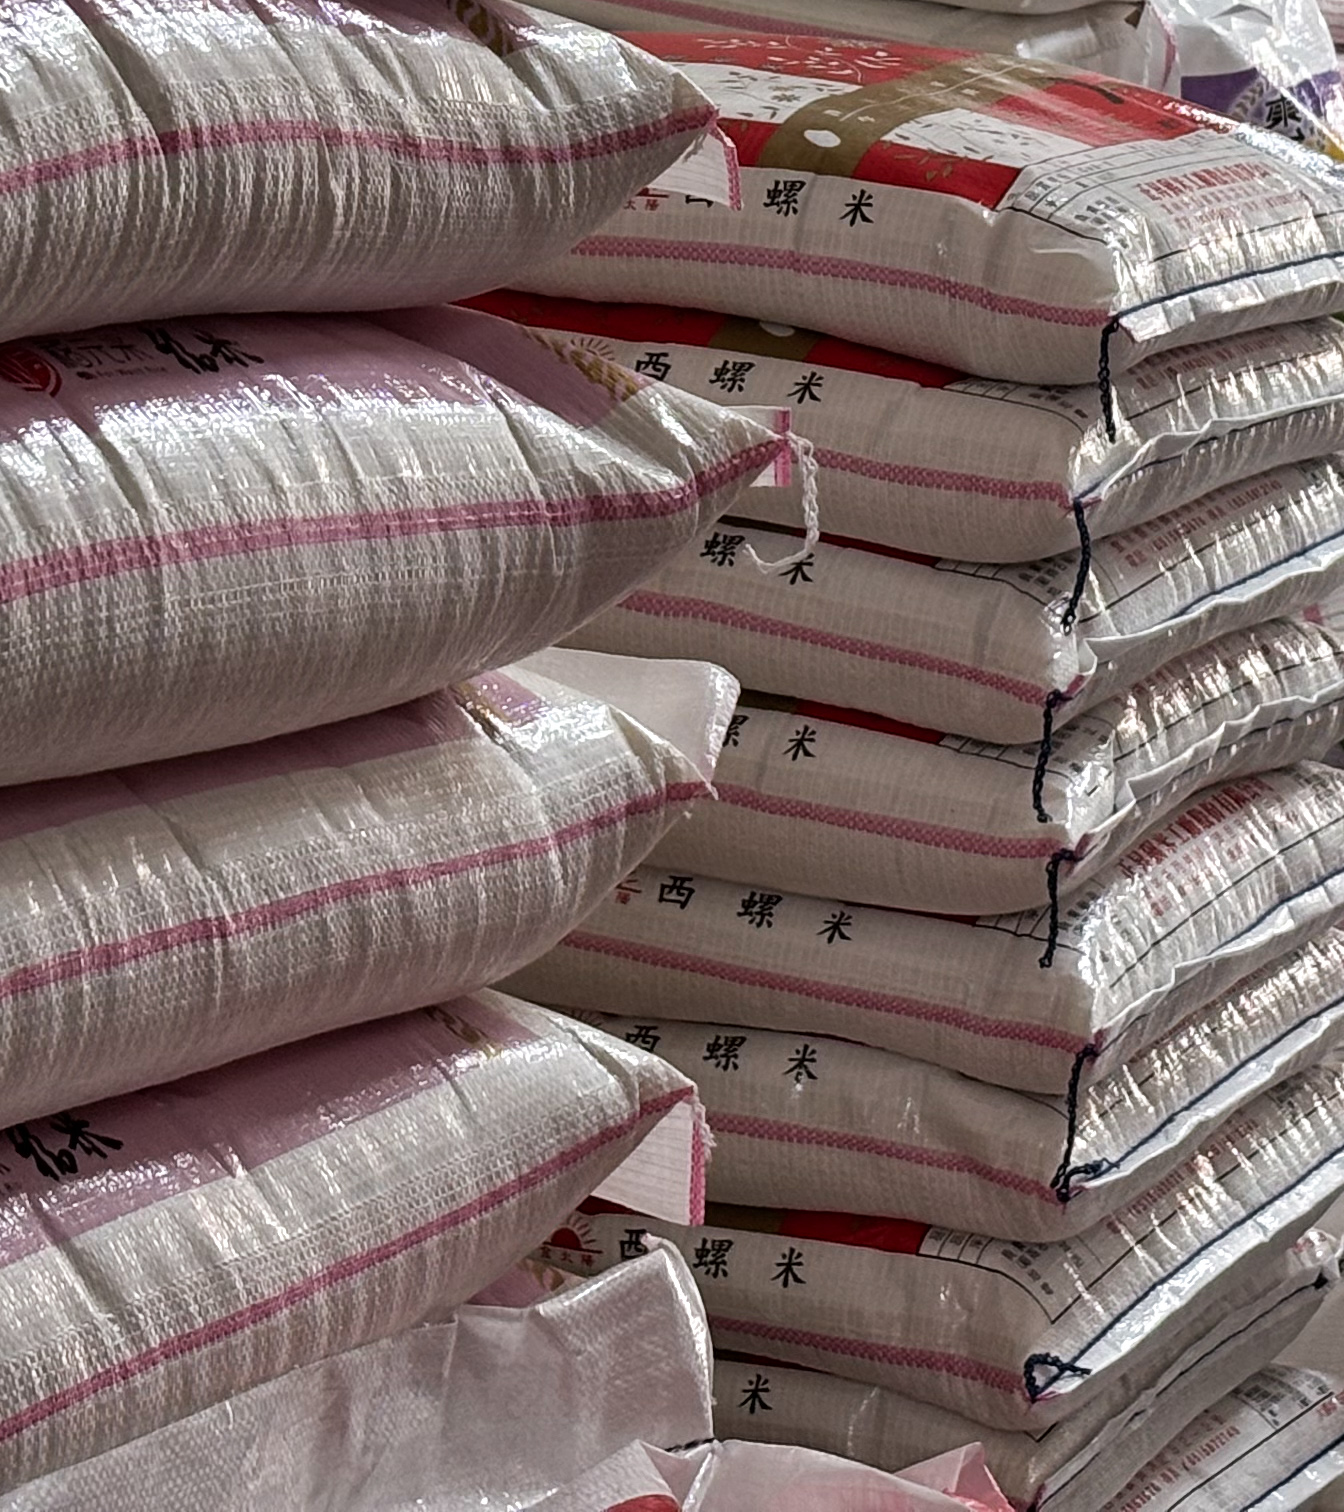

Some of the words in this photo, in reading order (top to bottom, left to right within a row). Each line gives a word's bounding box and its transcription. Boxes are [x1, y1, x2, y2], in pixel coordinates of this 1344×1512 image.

[634, 351, 823, 404] 西螺米
[657, 874, 853, 945] 西螺米
[625, 1024, 819, 1084] 西螺米
[620, 1228, 806, 1288] 西螺米
[738, 1373, 773, 1415] 米
